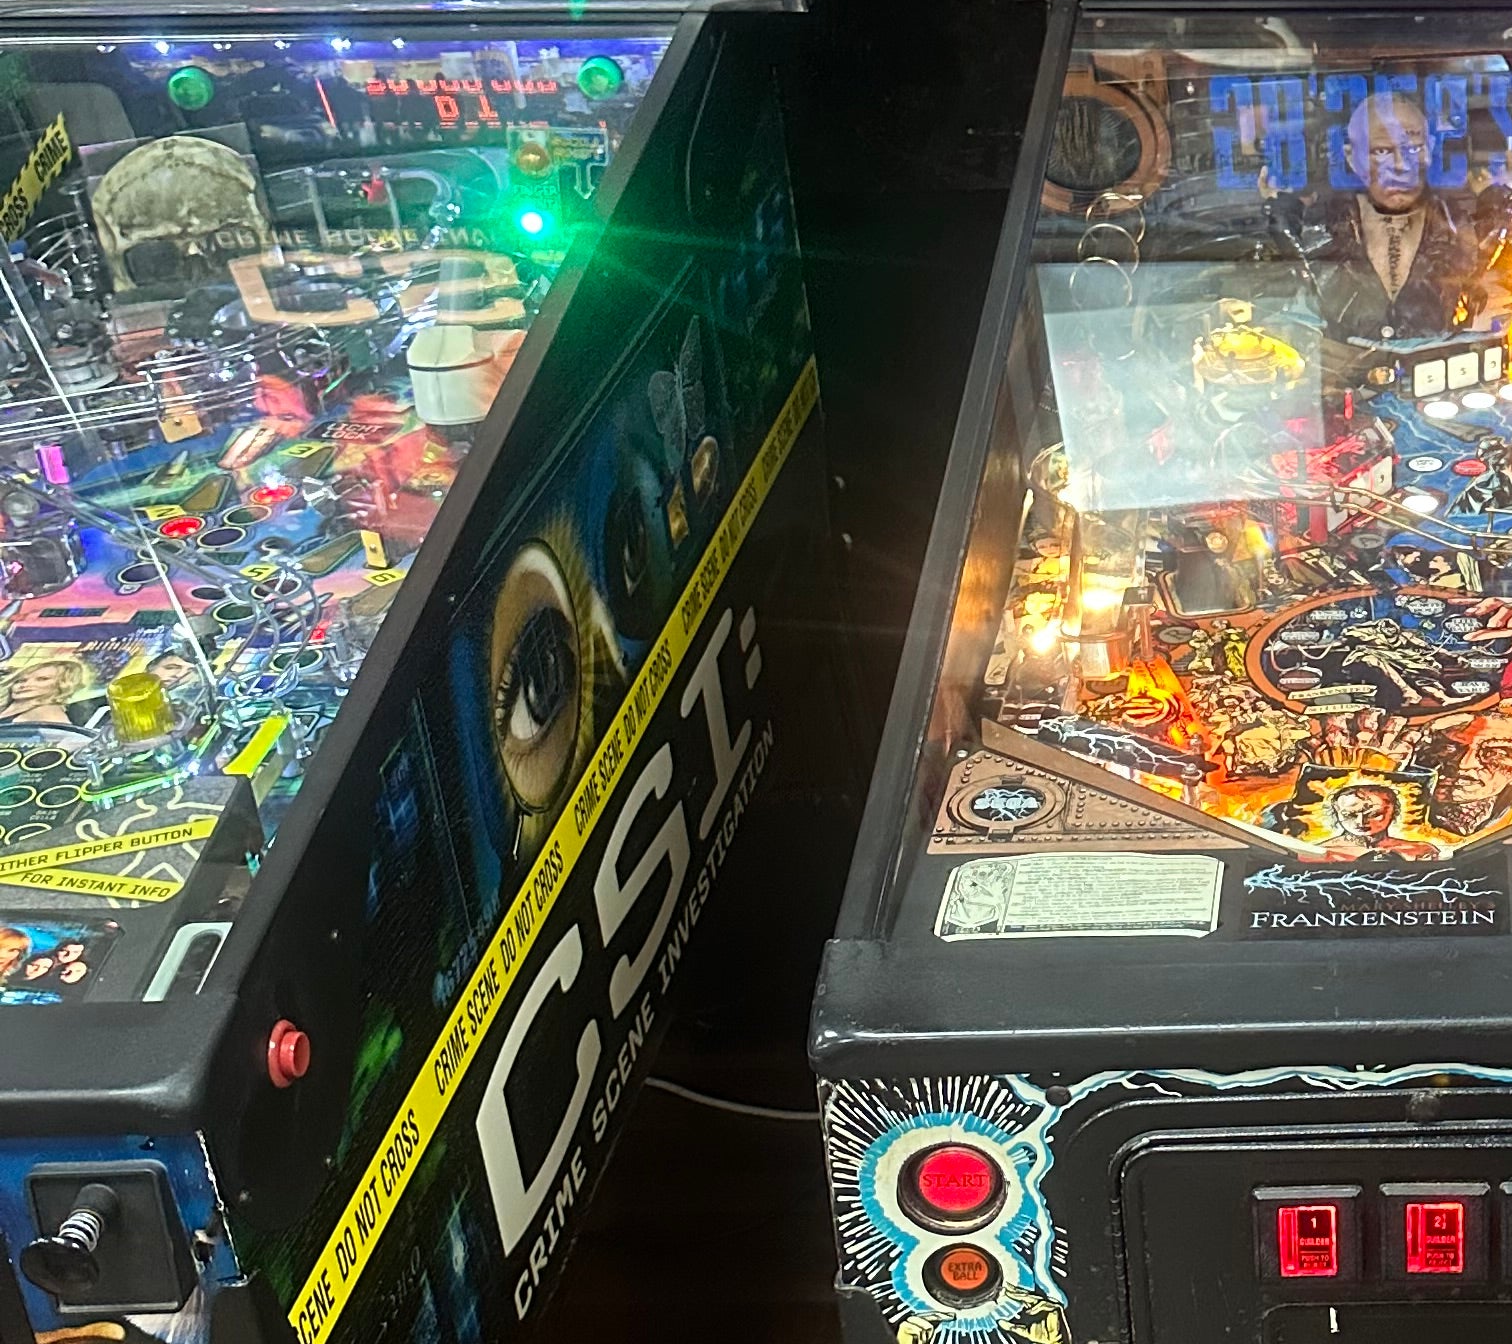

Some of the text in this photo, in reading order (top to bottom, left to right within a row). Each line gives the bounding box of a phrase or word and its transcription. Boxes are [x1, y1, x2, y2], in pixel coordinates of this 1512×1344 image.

[321, 430, 372, 441] LOCK
[326, 422, 383, 434] LIGHT
[572, 637, 673, 836] CRIME SCENE DO NOT CROSS
[55, 840, 124, 862] FLIPPER
[130, 827, 194, 847] BUTTON
[20, 872, 171, 898] FOR INSTANT INFO
[1249, 910, 1496, 929] FRANKENSTEIN
[476, 606, 763, 1259] CSI:
[433, 1029, 471, 1097] CRIME
[467, 957, 501, 1036] SCENE
[499, 927, 517, 975] DO
[513, 888, 536, 949] NOT
[533, 844, 565, 913] CROSS
[514, 720, 776, 1321] CRIME SCENE INVESTIGATION
[335, 1230, 358, 1268] DO
[350, 1185, 384, 1240] NOT
[382, 1109, 422, 1187] CROSS
[922, 1173, 988, 1188] START
[1310, 1216, 1317, 1229] 1
[948, 1261, 982, 1273] EXTRA
[953, 1271, 979, 1281] BALL
